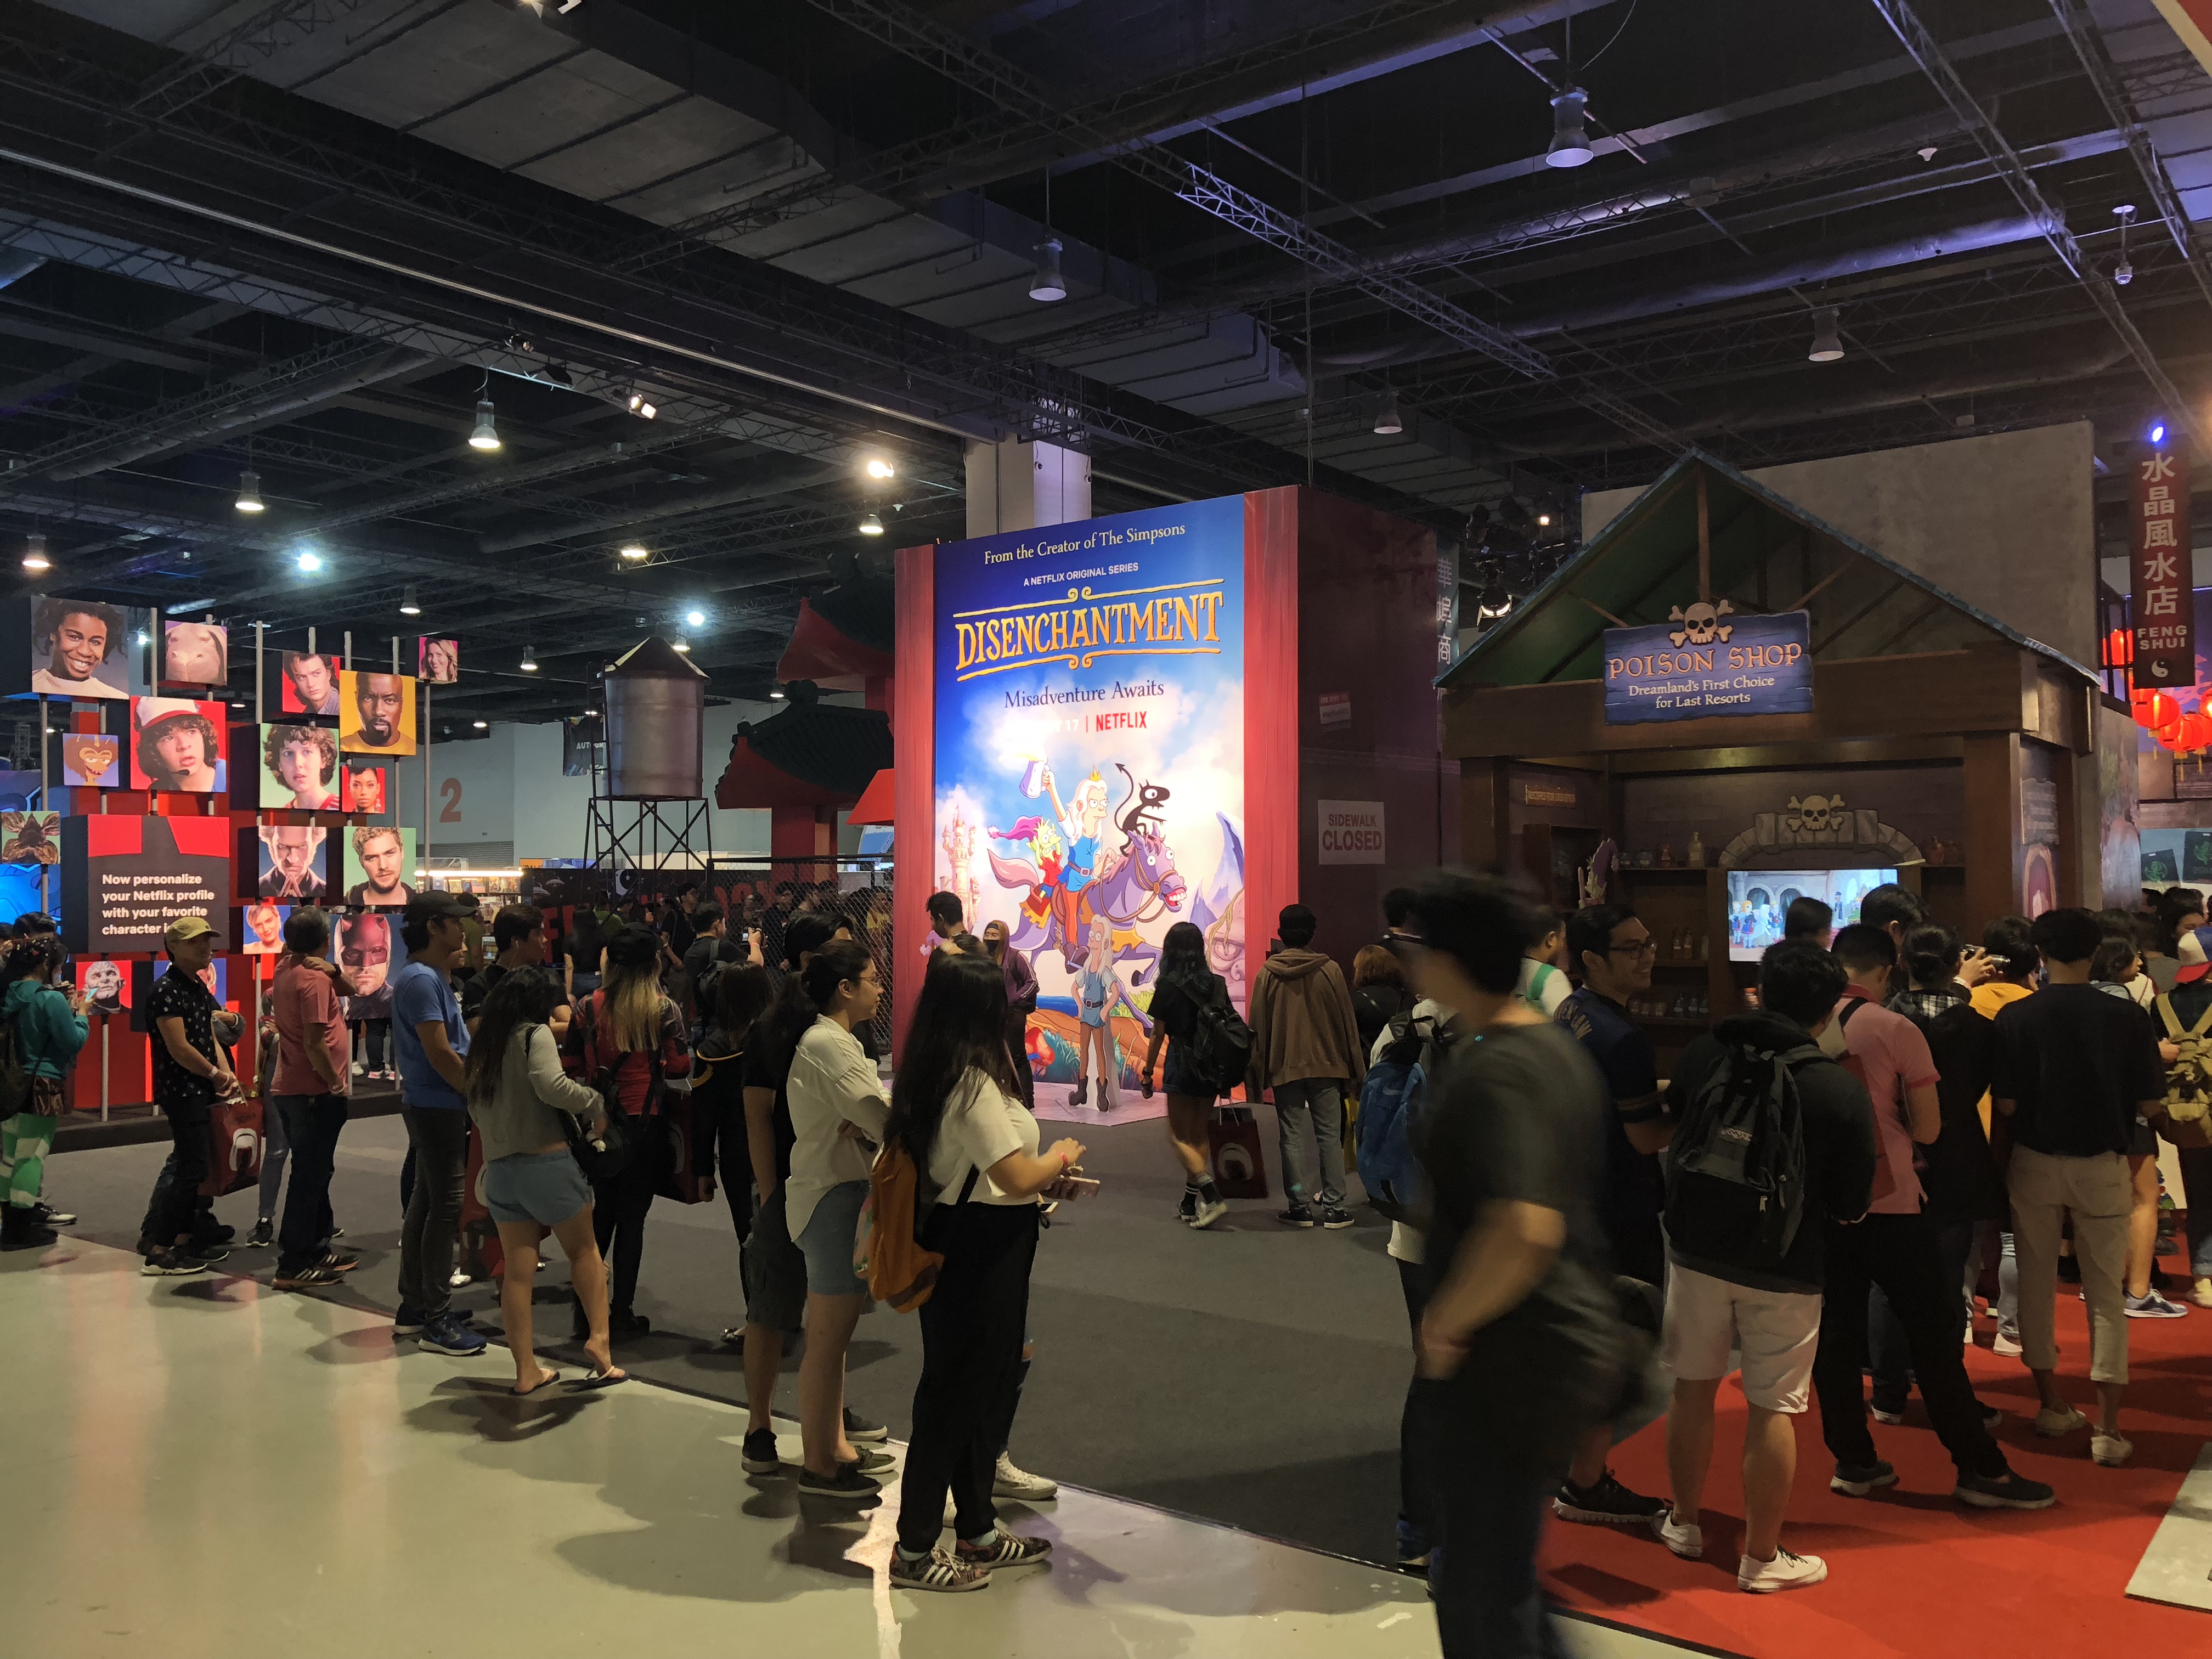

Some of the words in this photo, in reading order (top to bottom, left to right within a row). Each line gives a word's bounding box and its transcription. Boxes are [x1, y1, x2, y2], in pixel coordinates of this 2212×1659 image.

[2141, 452, 2178, 616] 水晶風水店
[984, 551, 1013, 565] From
[1017, 544, 1034, 560] the
[1037, 541, 1081, 557] Creator
[1084, 532, 1097, 549] of
[1099, 529, 1123, 547] The
[1126, 525, 1186, 544] Simpsons
[1023, 578, 1030, 587] A
[1031, 573, 1065, 585] NETFLIX
[1066, 567, 1107, 581] ORIGINAL
[1108, 562, 1139, 574] SERIES
[955, 591, 1224, 671] DISENCHANTMENT
[1436, 556, 1452, 701] 華埠商
[2137, 625, 2187, 639] FENG
[2140, 637, 2186, 651] SHUI
[1608, 649, 1715, 680] POISON
[1729, 642, 1802, 670] SHOP
[1004, 685, 1106, 708] Misadventure
[1111, 679, 1164, 699] Awaits
[1629, 679, 1699, 697] Dreamland's
[1702, 678, 1730, 692] First
[1733, 674, 1775, 689] Choice
[1655, 696, 1673, 709] for
[1675, 695, 1701, 707] Last
[1705, 692, 1751, 705] Resorts
[1065, 719, 1079, 731] 17
[1096, 711, 1147, 732] NETFLIX
[439, 777, 462, 823] 2
[1328, 814, 1377, 827] SIDEWALK
[1322, 830, 1383, 851] CLOSED
[102, 874, 131, 885] Now
[133, 873, 202, 887] personalize
[101, 892, 131, 904] your
[133, 889, 174, 901] Netflix
[176, 889, 215, 903] profile
[101, 907, 129, 918] with
[132, 908, 160, 921] your
[161, 906, 208, 917] favorite
[101, 923, 161, 935] character
